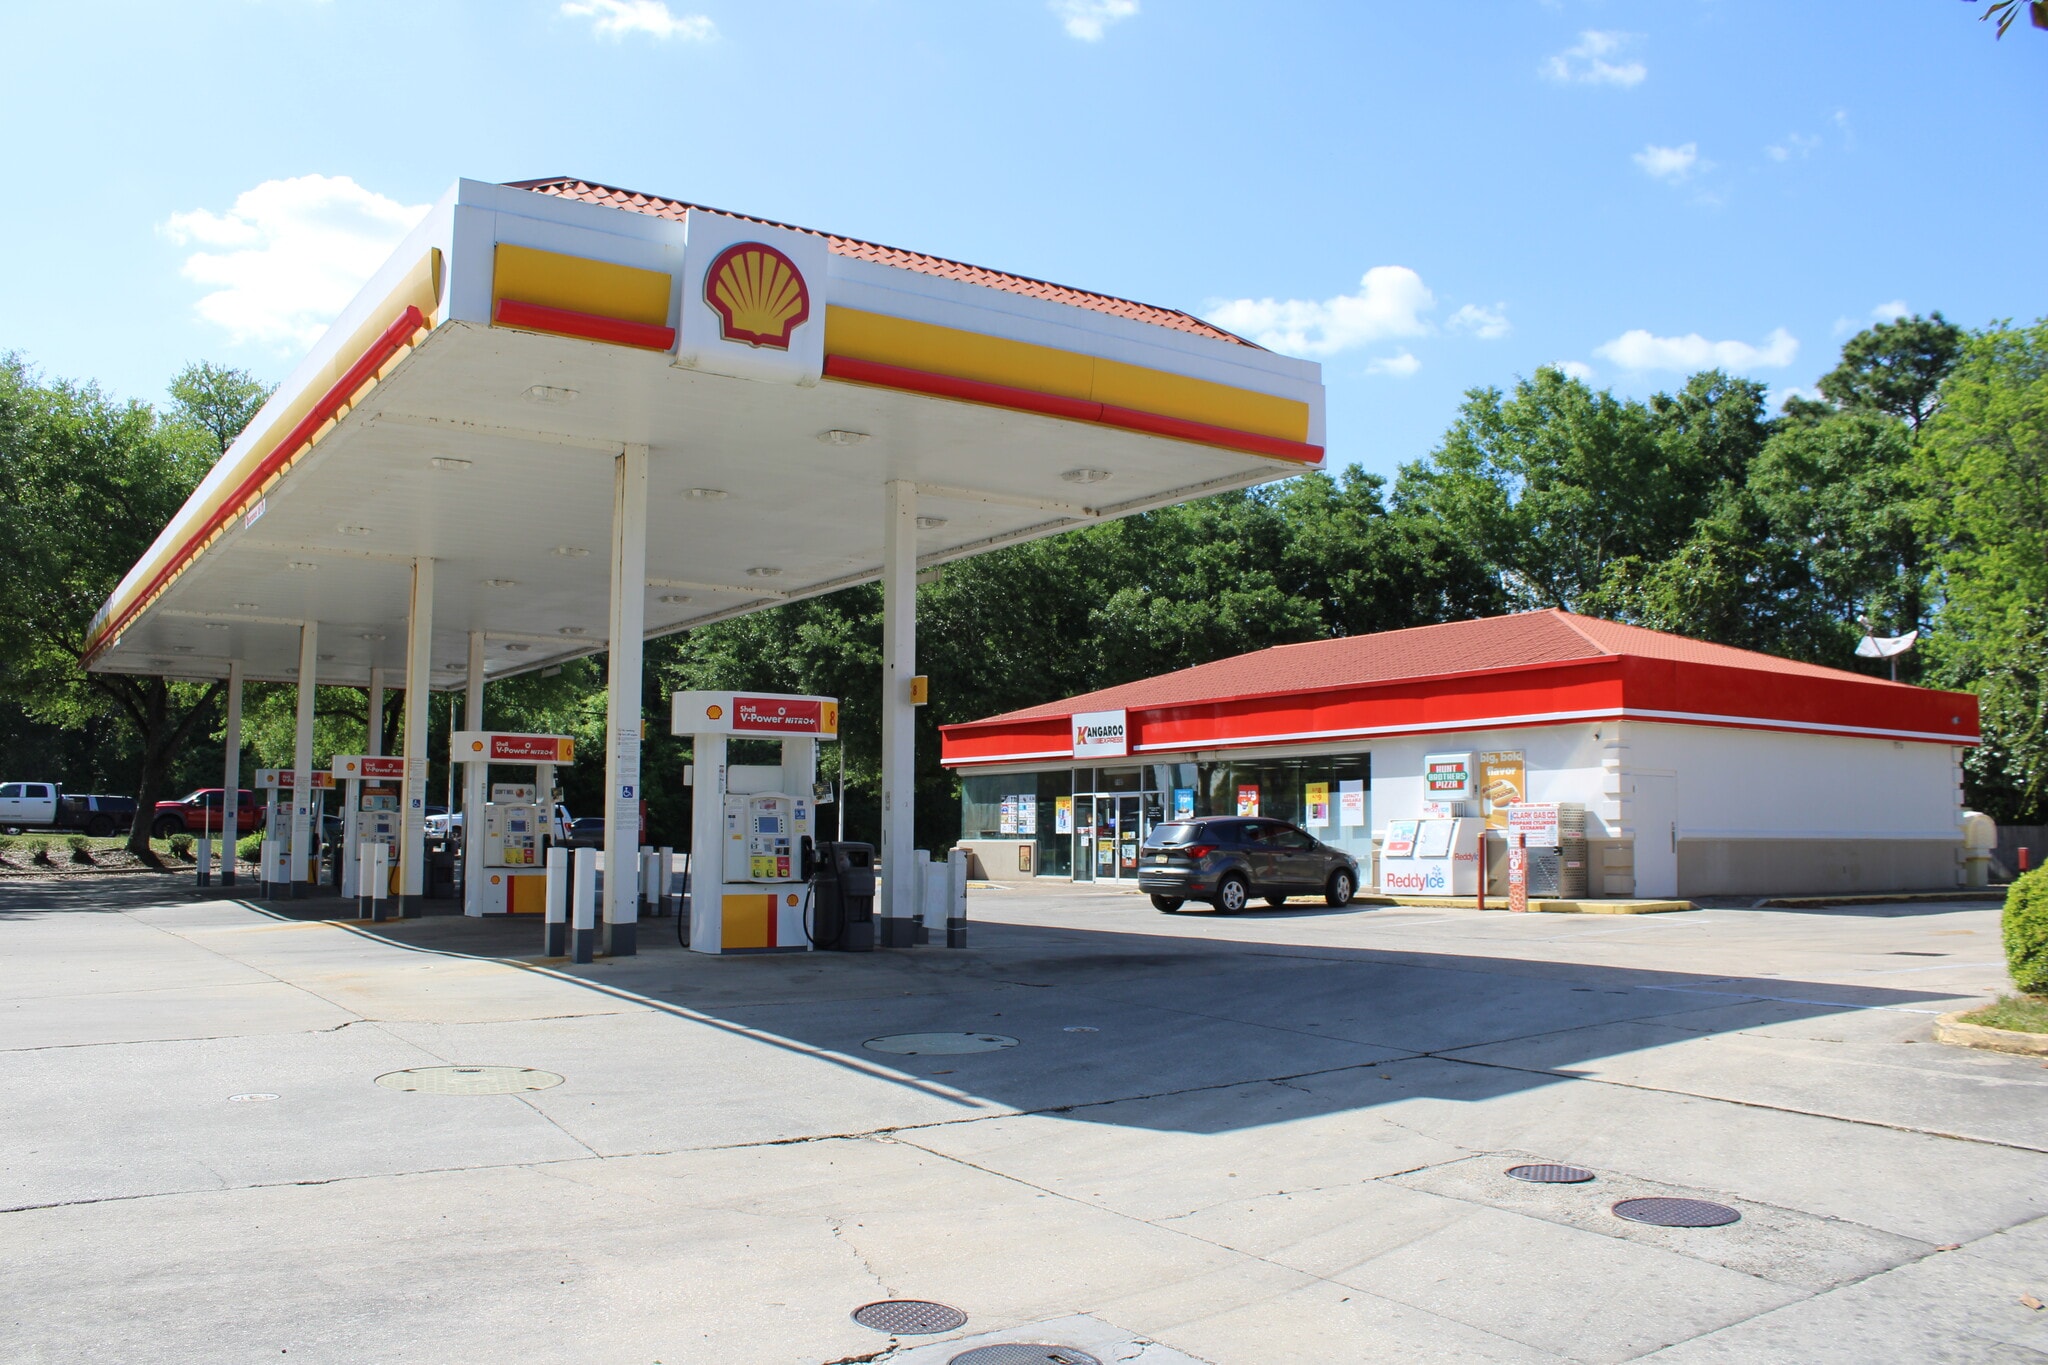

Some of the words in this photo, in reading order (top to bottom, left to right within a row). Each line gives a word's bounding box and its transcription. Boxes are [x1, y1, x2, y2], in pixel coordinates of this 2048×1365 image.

[740, 713, 782, 724] V-Power
[829, 711, 836, 726] 8
[1076, 725, 1124, 745] KANGAROO
[566, 744, 572, 756] 6
[1480, 752, 1498, 764] big,
[1501, 752, 1522, 761] bold
[1428, 773, 1466, 781] BROTHERS
[1487, 766, 1516, 776] flavor
[1512, 811, 1532, 819] CLARK
[1533, 811, 1546, 819] GAS
[1387, 872, 1444, 890] ReddyIce
